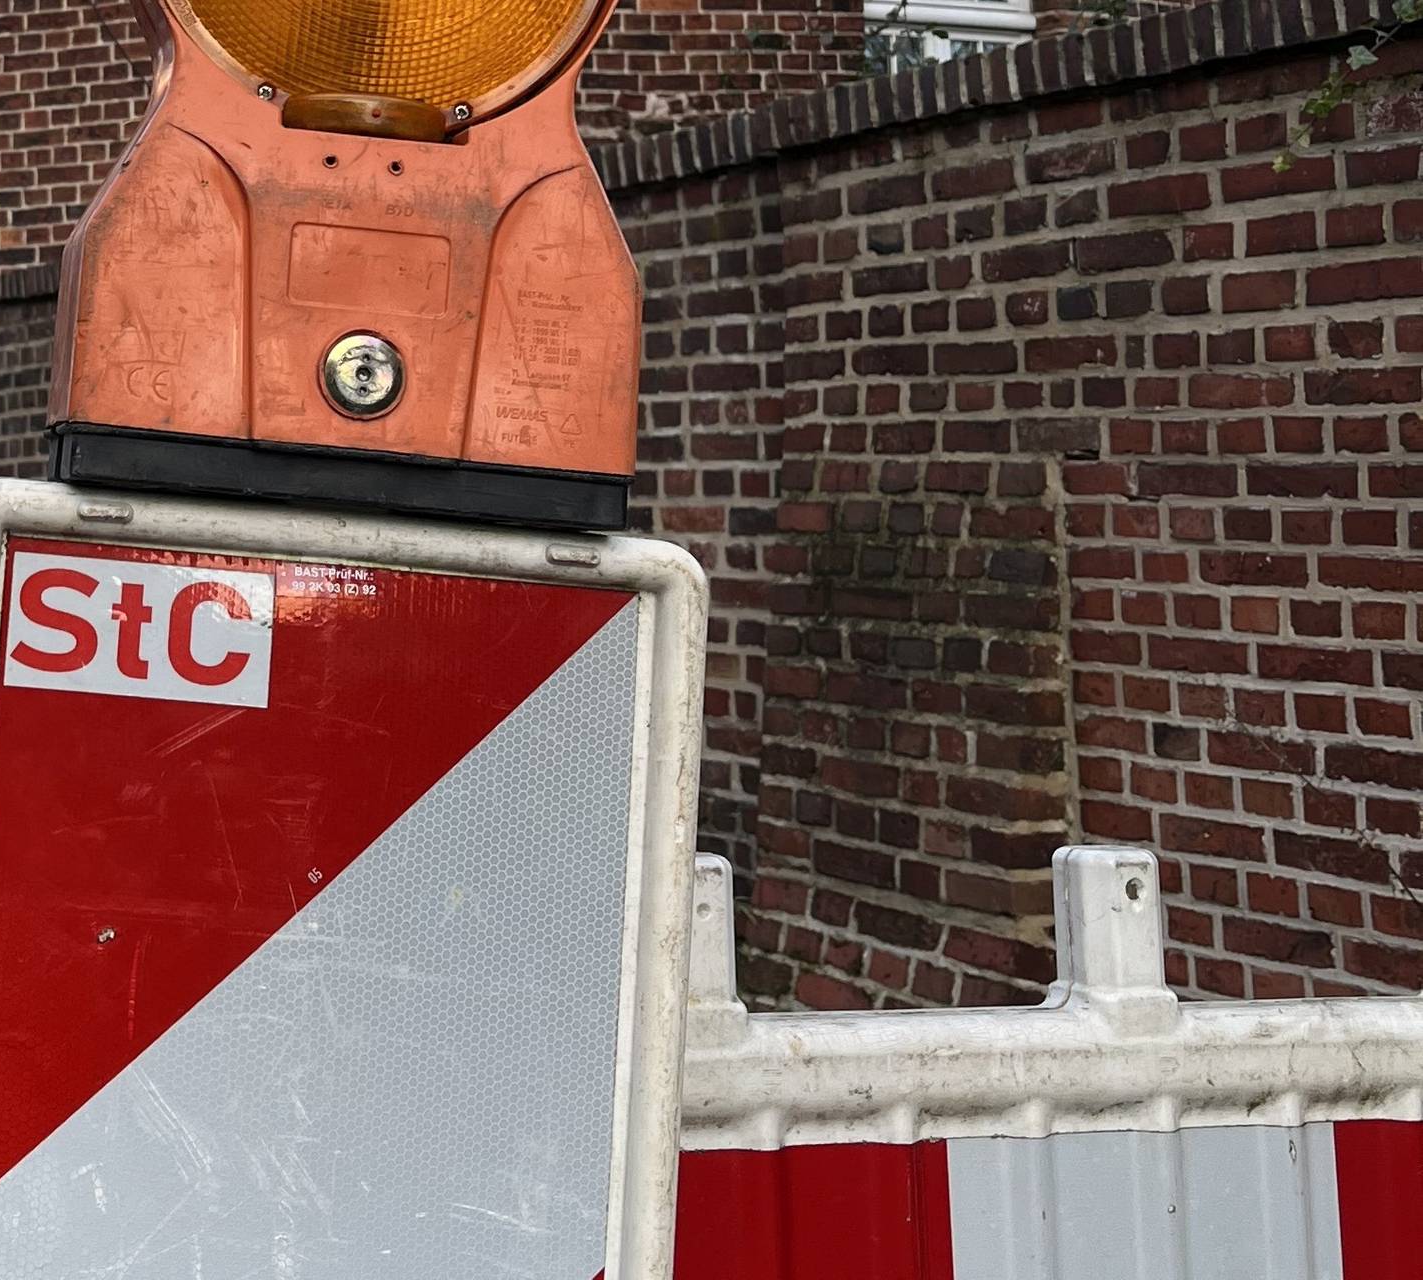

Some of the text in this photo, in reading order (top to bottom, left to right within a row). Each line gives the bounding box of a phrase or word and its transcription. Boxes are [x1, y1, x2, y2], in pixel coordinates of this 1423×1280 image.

[362, 584, 377, 595] 92
[10, 567, 252, 686] StC
[307, 866, 323, 884] 05
